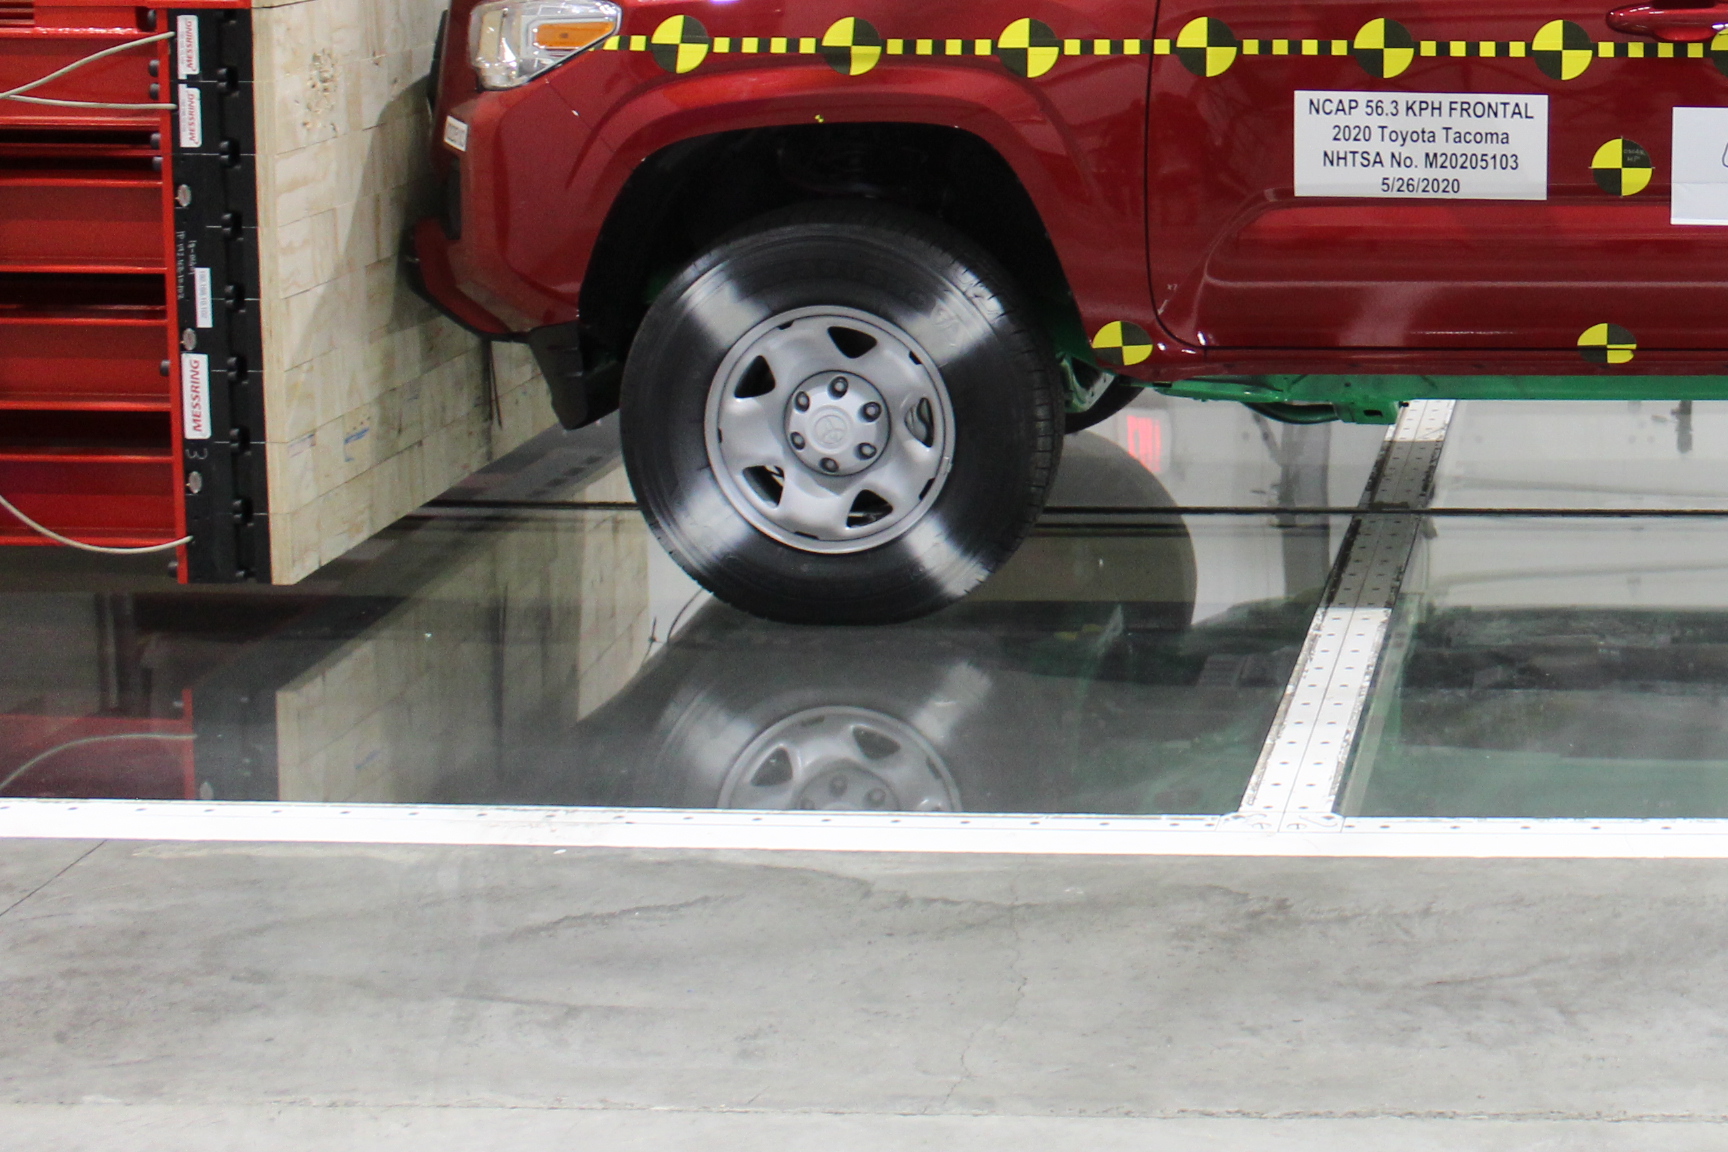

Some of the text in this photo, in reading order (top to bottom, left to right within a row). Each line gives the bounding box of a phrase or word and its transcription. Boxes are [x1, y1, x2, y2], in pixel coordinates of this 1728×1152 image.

[185, 20, 195, 69] MESSRING
[187, 93, 197, 142] MESSRING
[1308, 98, 1535, 119] NCAP 56.3 KPH FRONTAL
[1332, 124, 1510, 147] 2020 Toyota Tacoma
[1322, 150, 1519, 170] NHTSA No. M20205103
[1380, 177, 1461, 194] 5/26/2020
[189, 359, 203, 433] MESSRING
